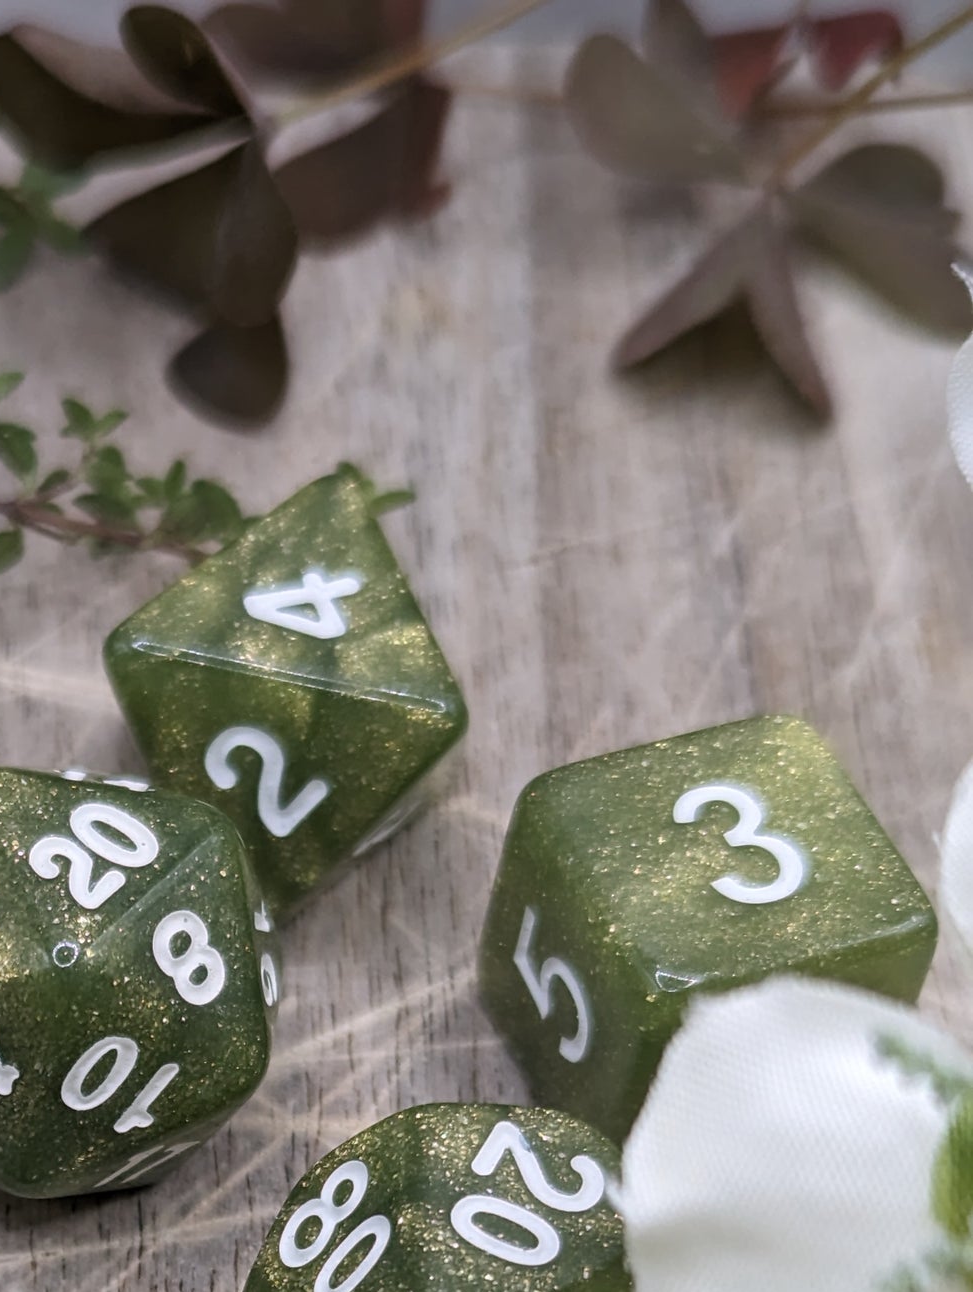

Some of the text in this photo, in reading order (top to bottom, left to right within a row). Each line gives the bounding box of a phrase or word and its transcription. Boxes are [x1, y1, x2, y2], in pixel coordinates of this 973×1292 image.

[243, 572, 359, 639] 4
[204, 726, 328, 837] 2
[29, 803, 159, 909] 20
[672, 785, 805, 905] 3
[152, 909, 225, 1005] 8
[513, 905, 590, 1063] 5
[60, 1036, 179, 1133] 10
[450, 1120, 605, 1266] 20
